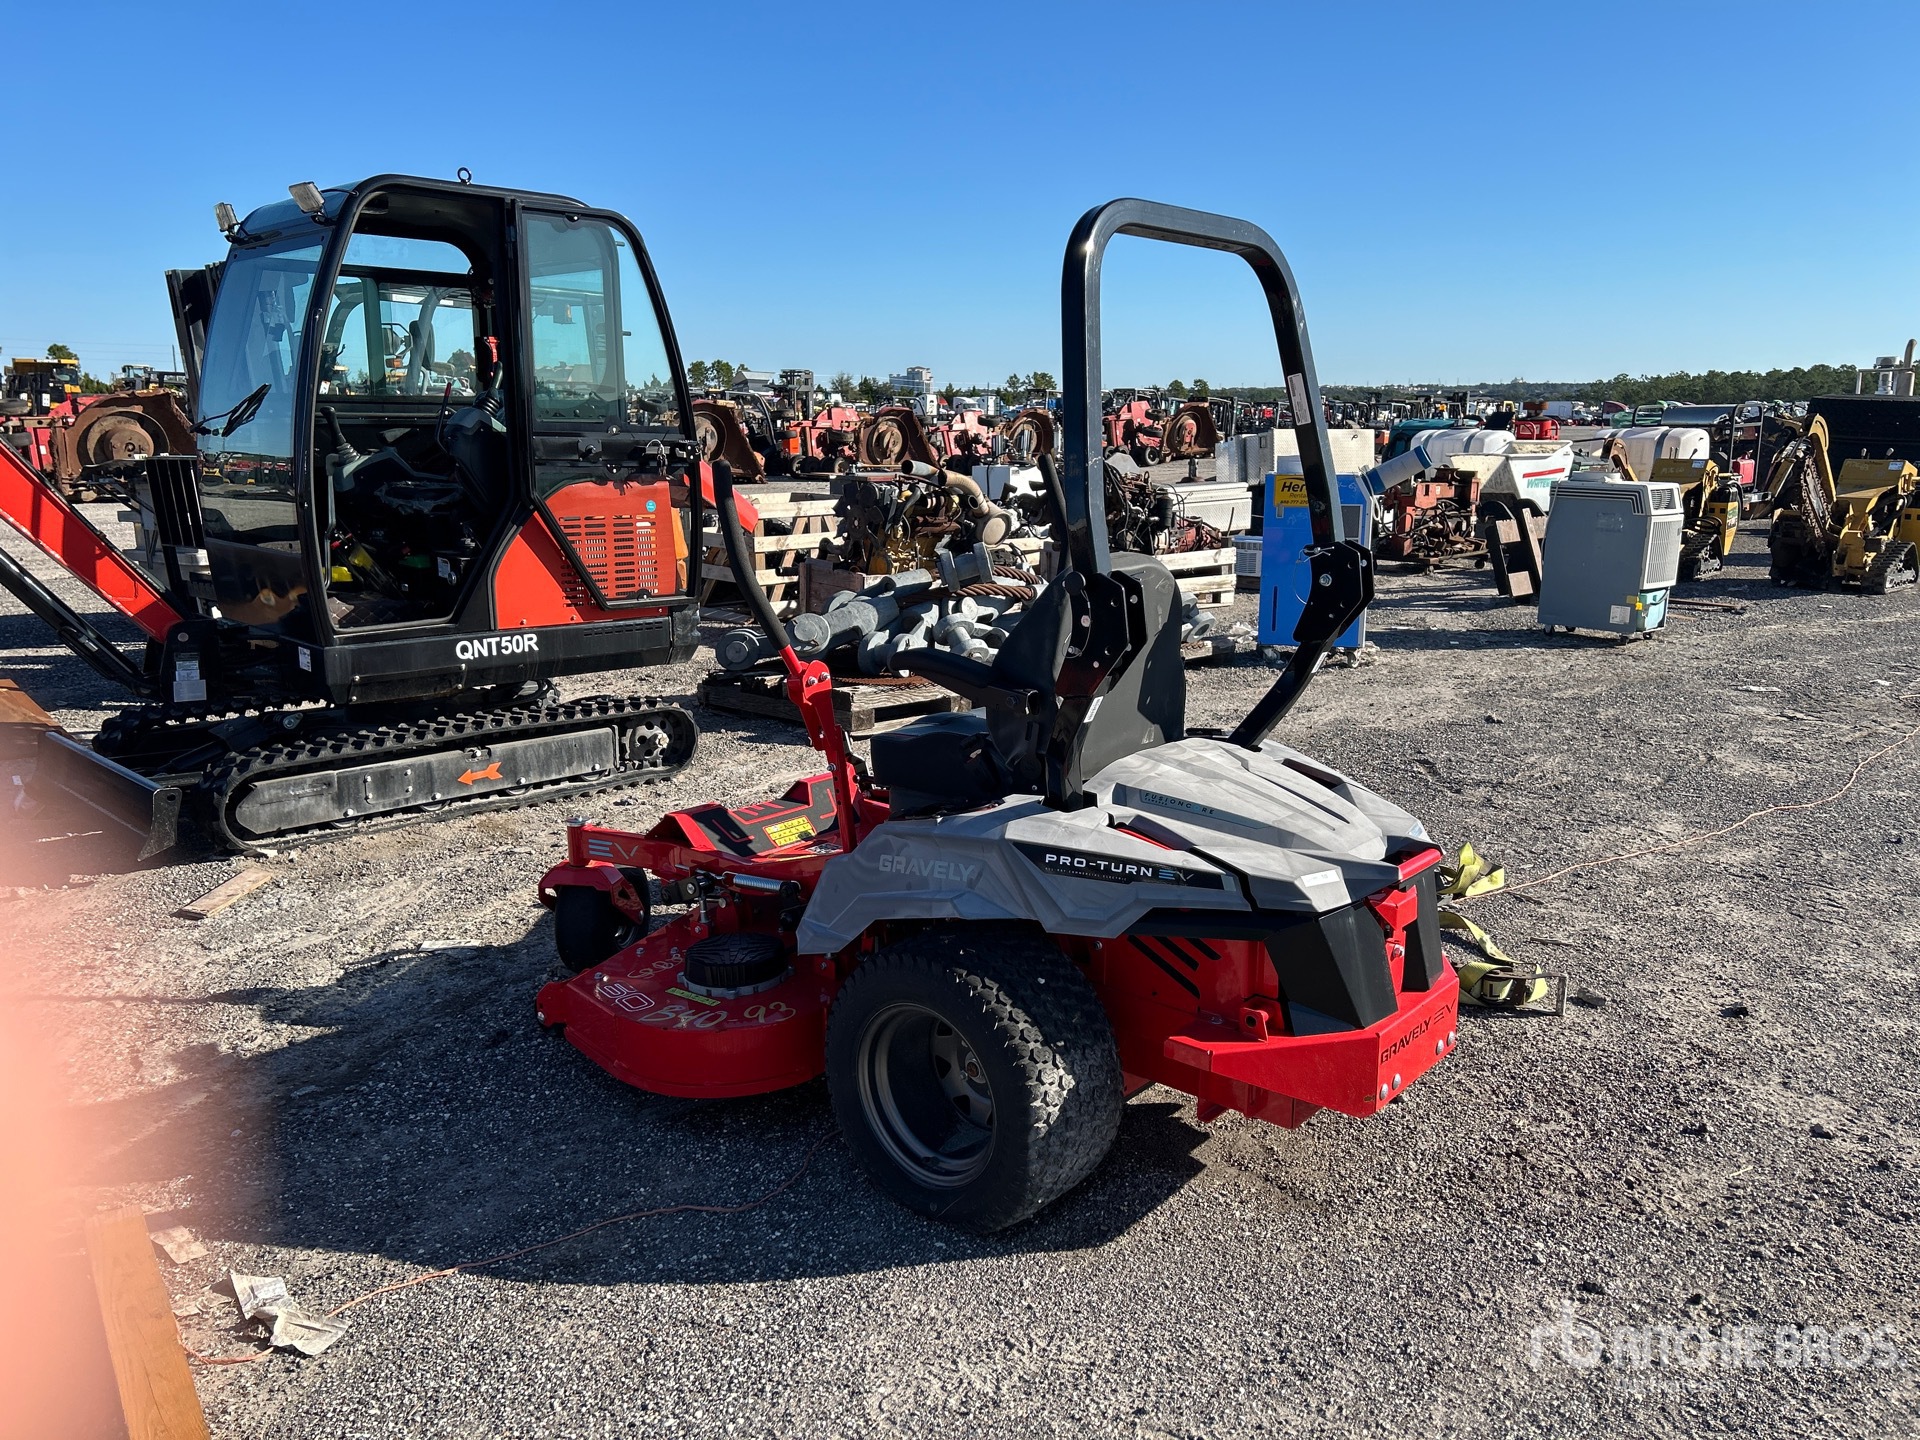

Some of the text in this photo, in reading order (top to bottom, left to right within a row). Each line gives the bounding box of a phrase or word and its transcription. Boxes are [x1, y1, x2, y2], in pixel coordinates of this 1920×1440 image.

[1281, 481, 1306, 493] Her
[455, 633, 539, 660] QNT50R
[588, 838, 639, 860] EV
[879, 854, 976, 882] GRAVELY
[1045, 853, 1195, 882] PRO-TURN EV
[1380, 998, 1456, 1066] GRAVELY EV
